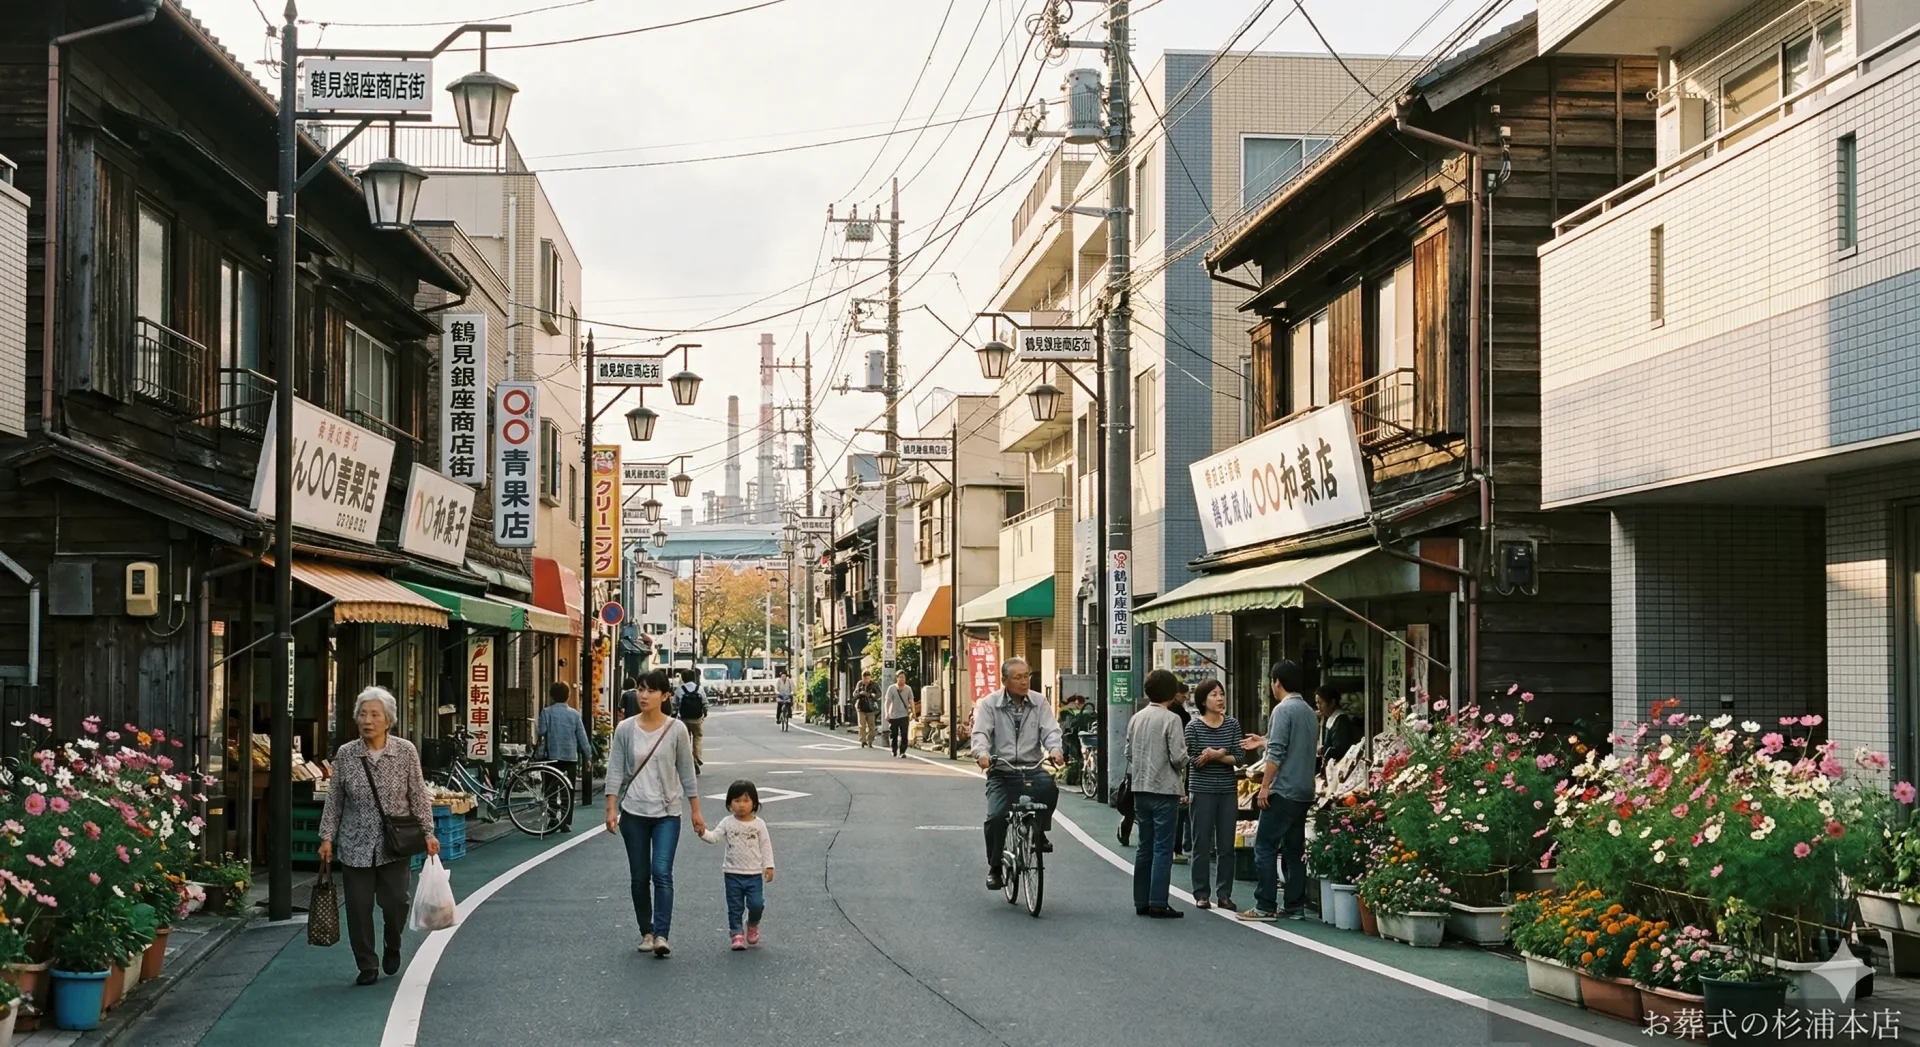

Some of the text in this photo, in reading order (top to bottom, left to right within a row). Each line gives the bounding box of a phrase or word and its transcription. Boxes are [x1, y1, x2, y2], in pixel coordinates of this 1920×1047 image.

[310, 70, 426, 100] 鶴見銀座商店街
[449, 320, 476, 479] 鶴見銀座商店街
[594, 479, 612, 572] クリーニング
